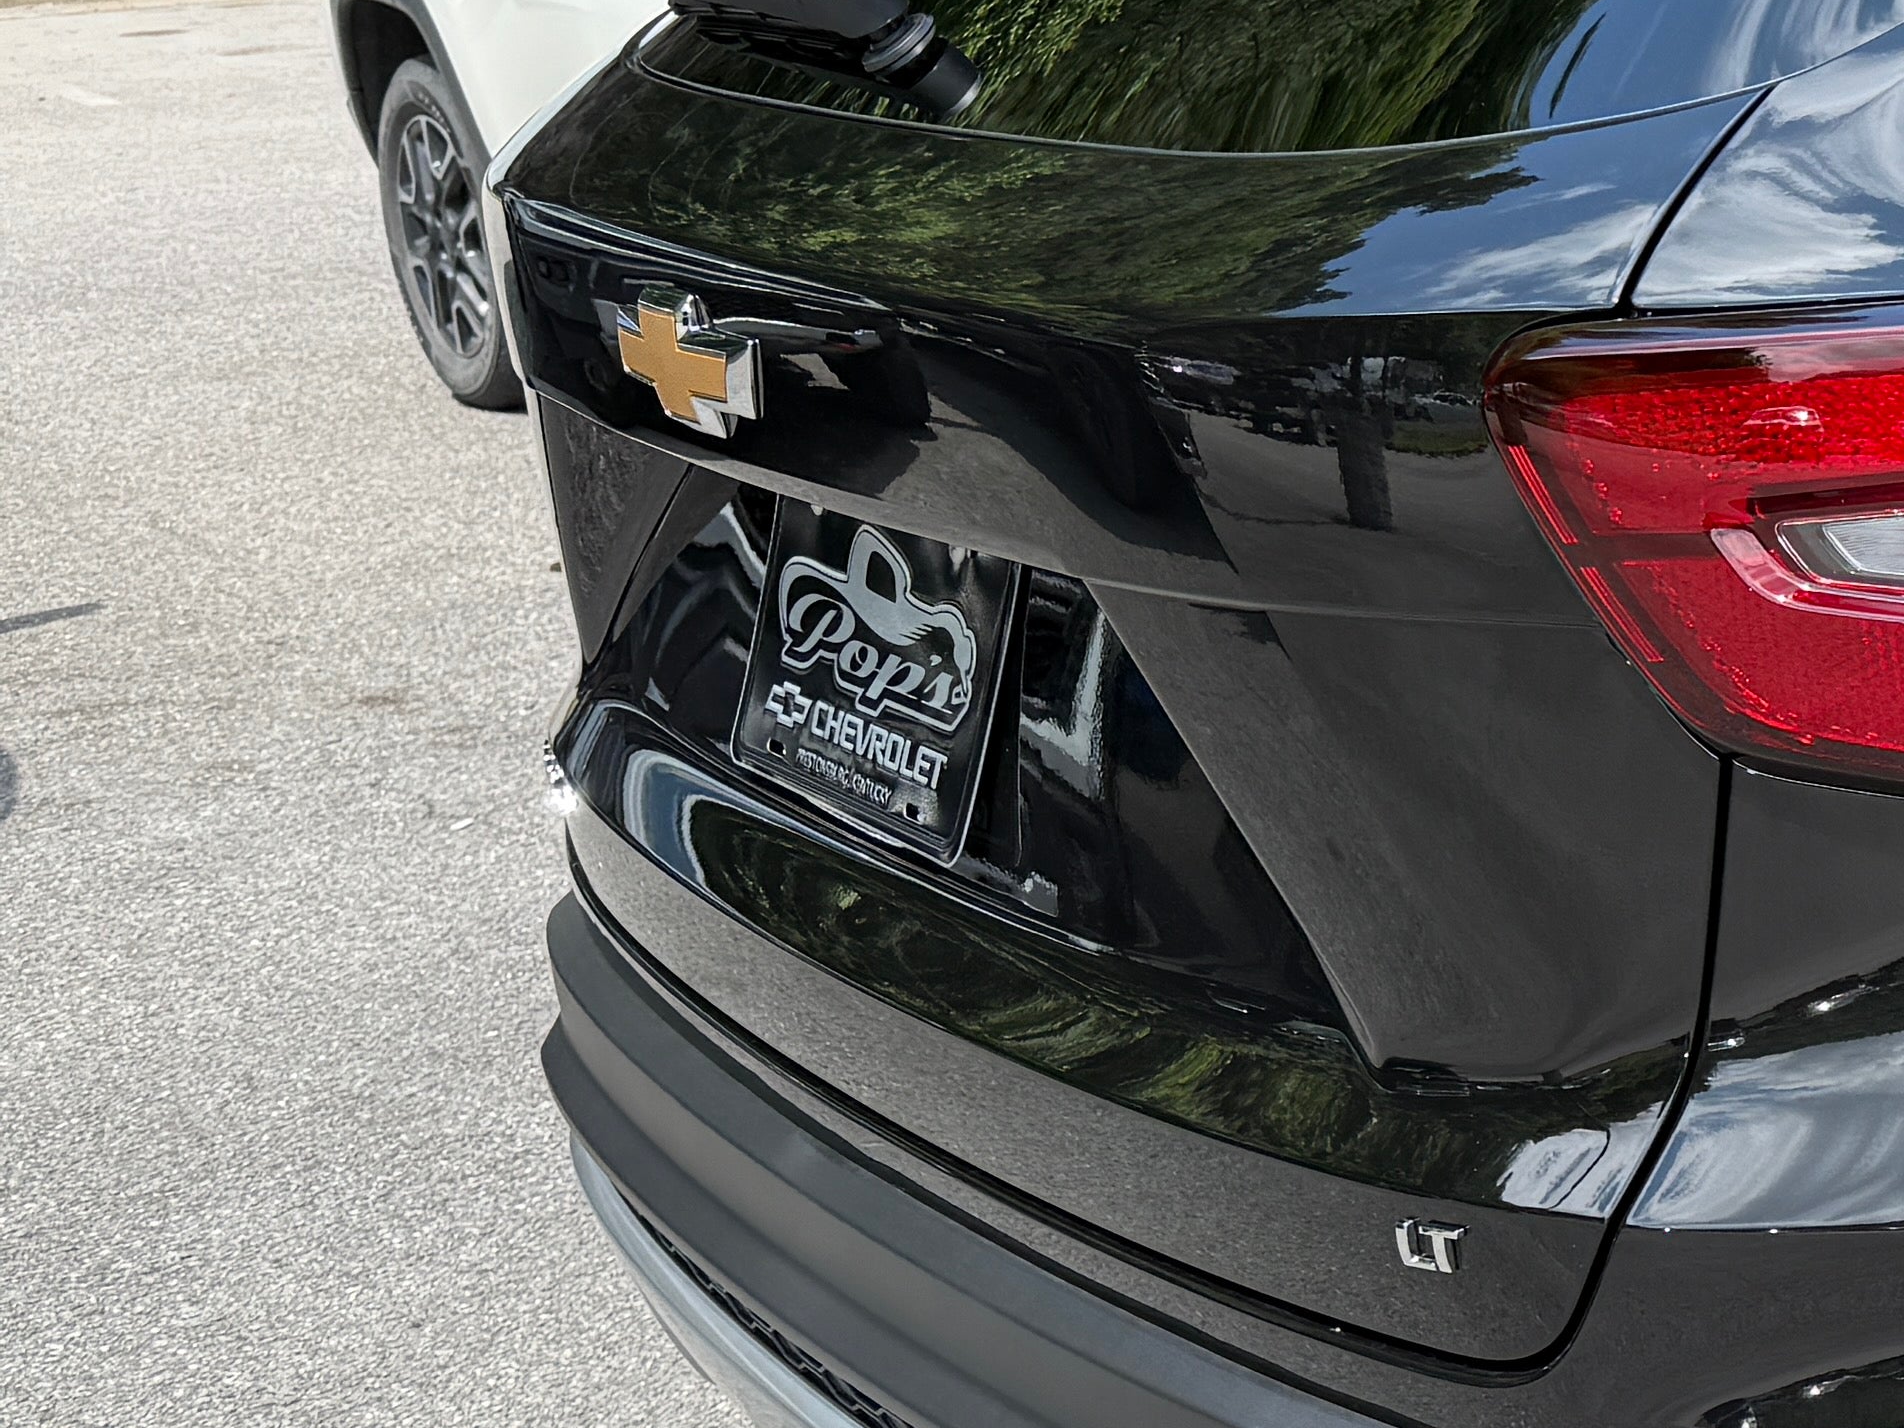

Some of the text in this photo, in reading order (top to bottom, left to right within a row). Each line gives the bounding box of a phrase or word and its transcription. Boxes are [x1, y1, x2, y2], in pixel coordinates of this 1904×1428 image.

[788, 592, 956, 712] Pop's
[811, 699, 949, 790] CHEVROLET
[1395, 1218, 1467, 1274] LT
